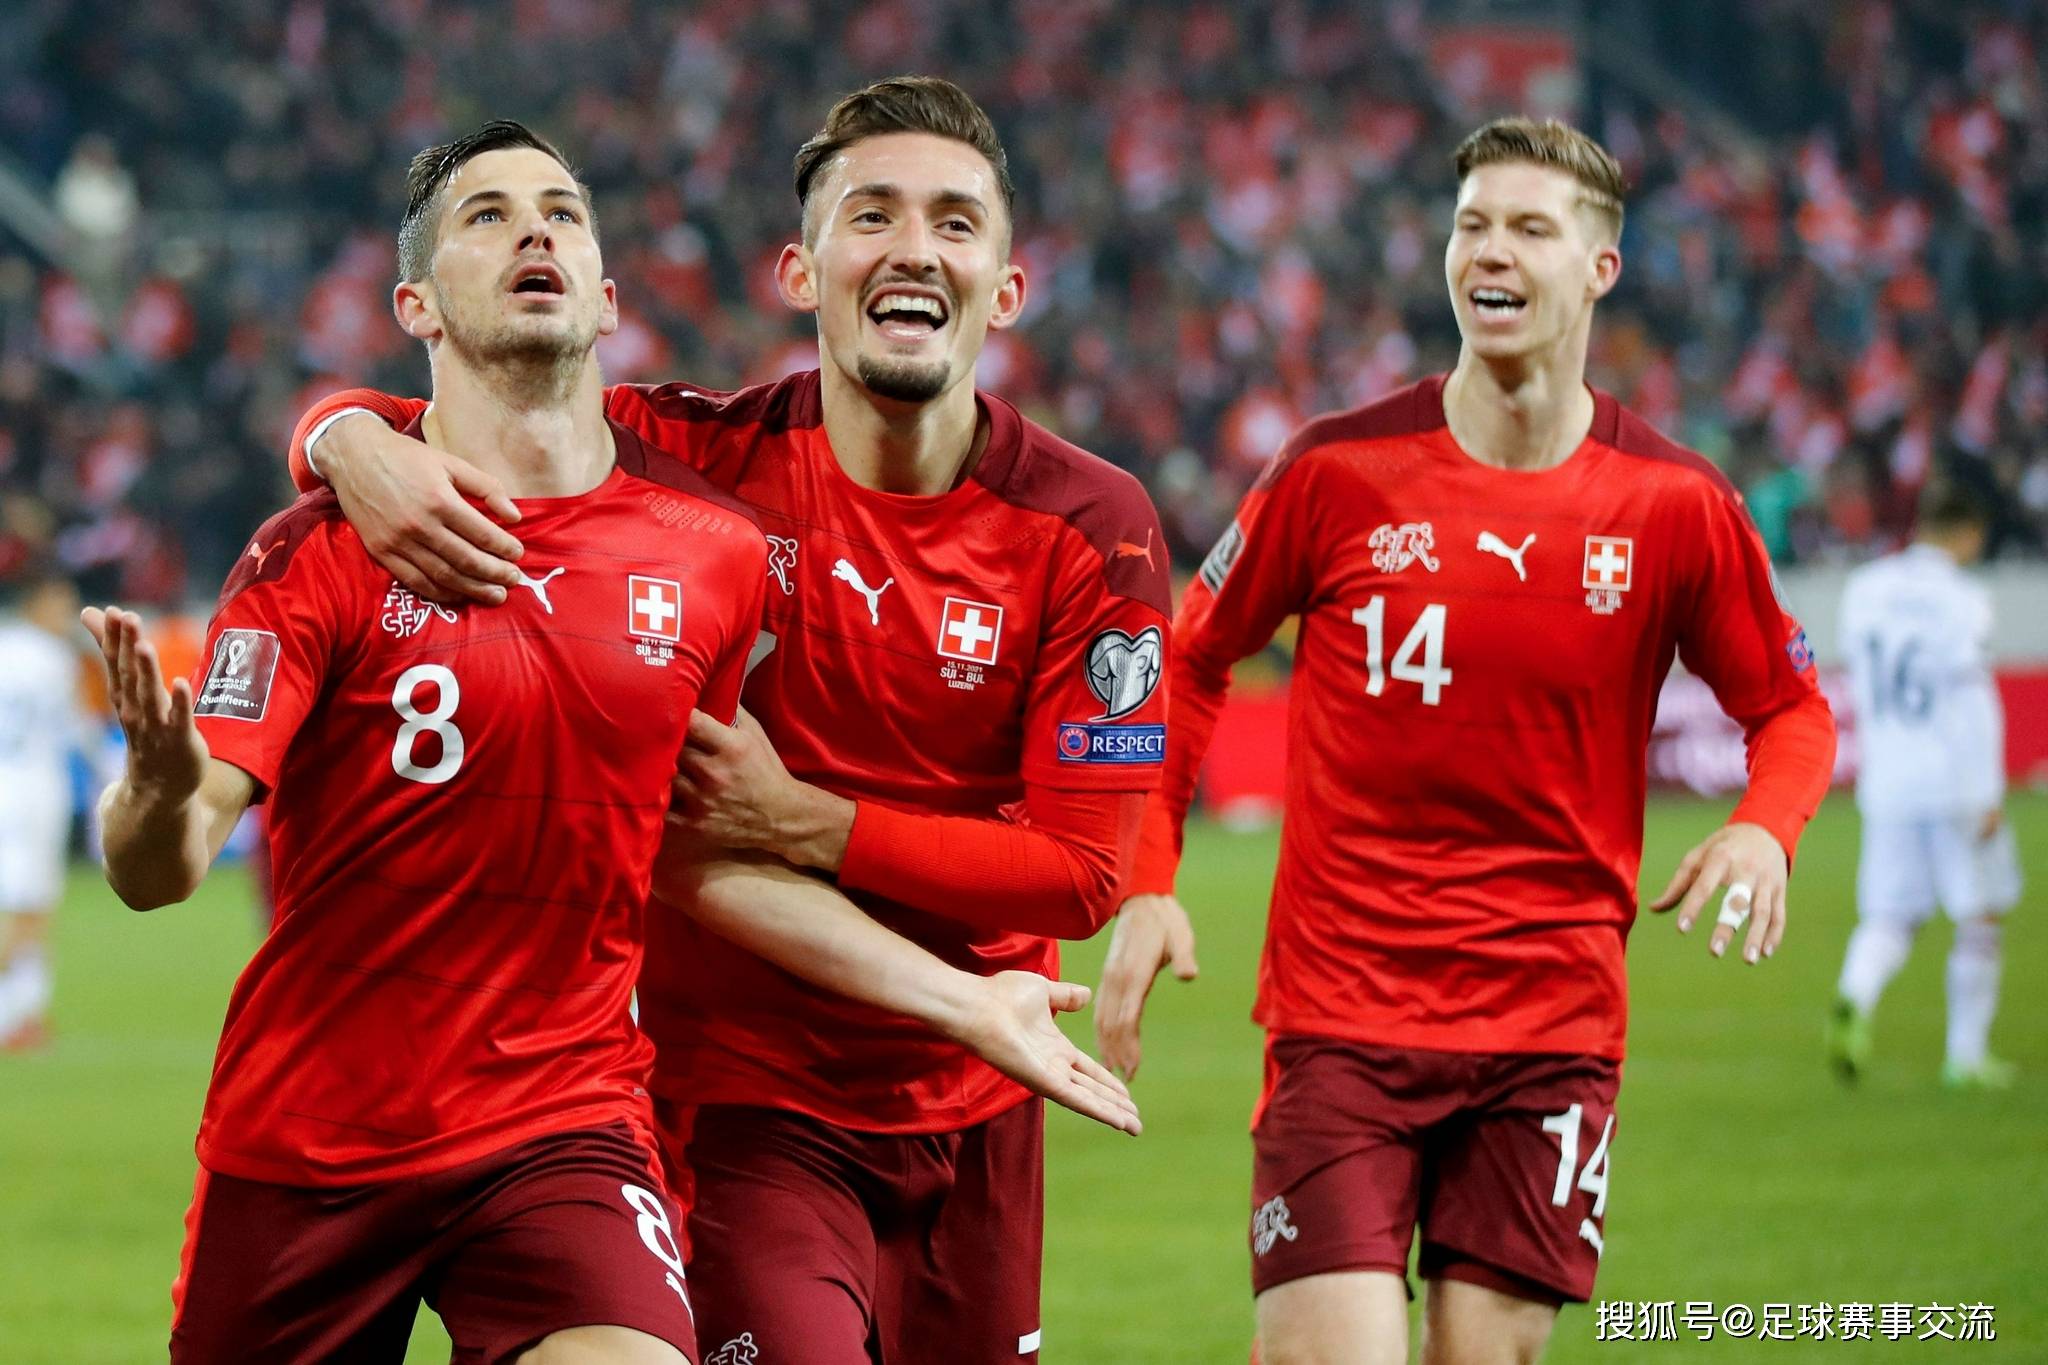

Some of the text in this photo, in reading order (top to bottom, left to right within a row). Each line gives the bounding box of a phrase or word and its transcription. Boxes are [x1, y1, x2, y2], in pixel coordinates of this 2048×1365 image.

[635, 644, 651, 656] SUI
[659, 647, 675, 659] BUL
[940, 667, 957, 679] SUI
[966, 672, 985, 684] BUL
[1352, 594, 1453, 706] 14
[1862, 625, 1937, 729] 16
[201, 694, 249, 707] Qualifiers
[948, 679, 975, 691] LUZERN
[392, 664, 464, 784] 8
[1092, 735, 1165, 752] RESPECT
[1542, 1103, 1615, 1218] 14
[621, 1183, 686, 1280] 8
